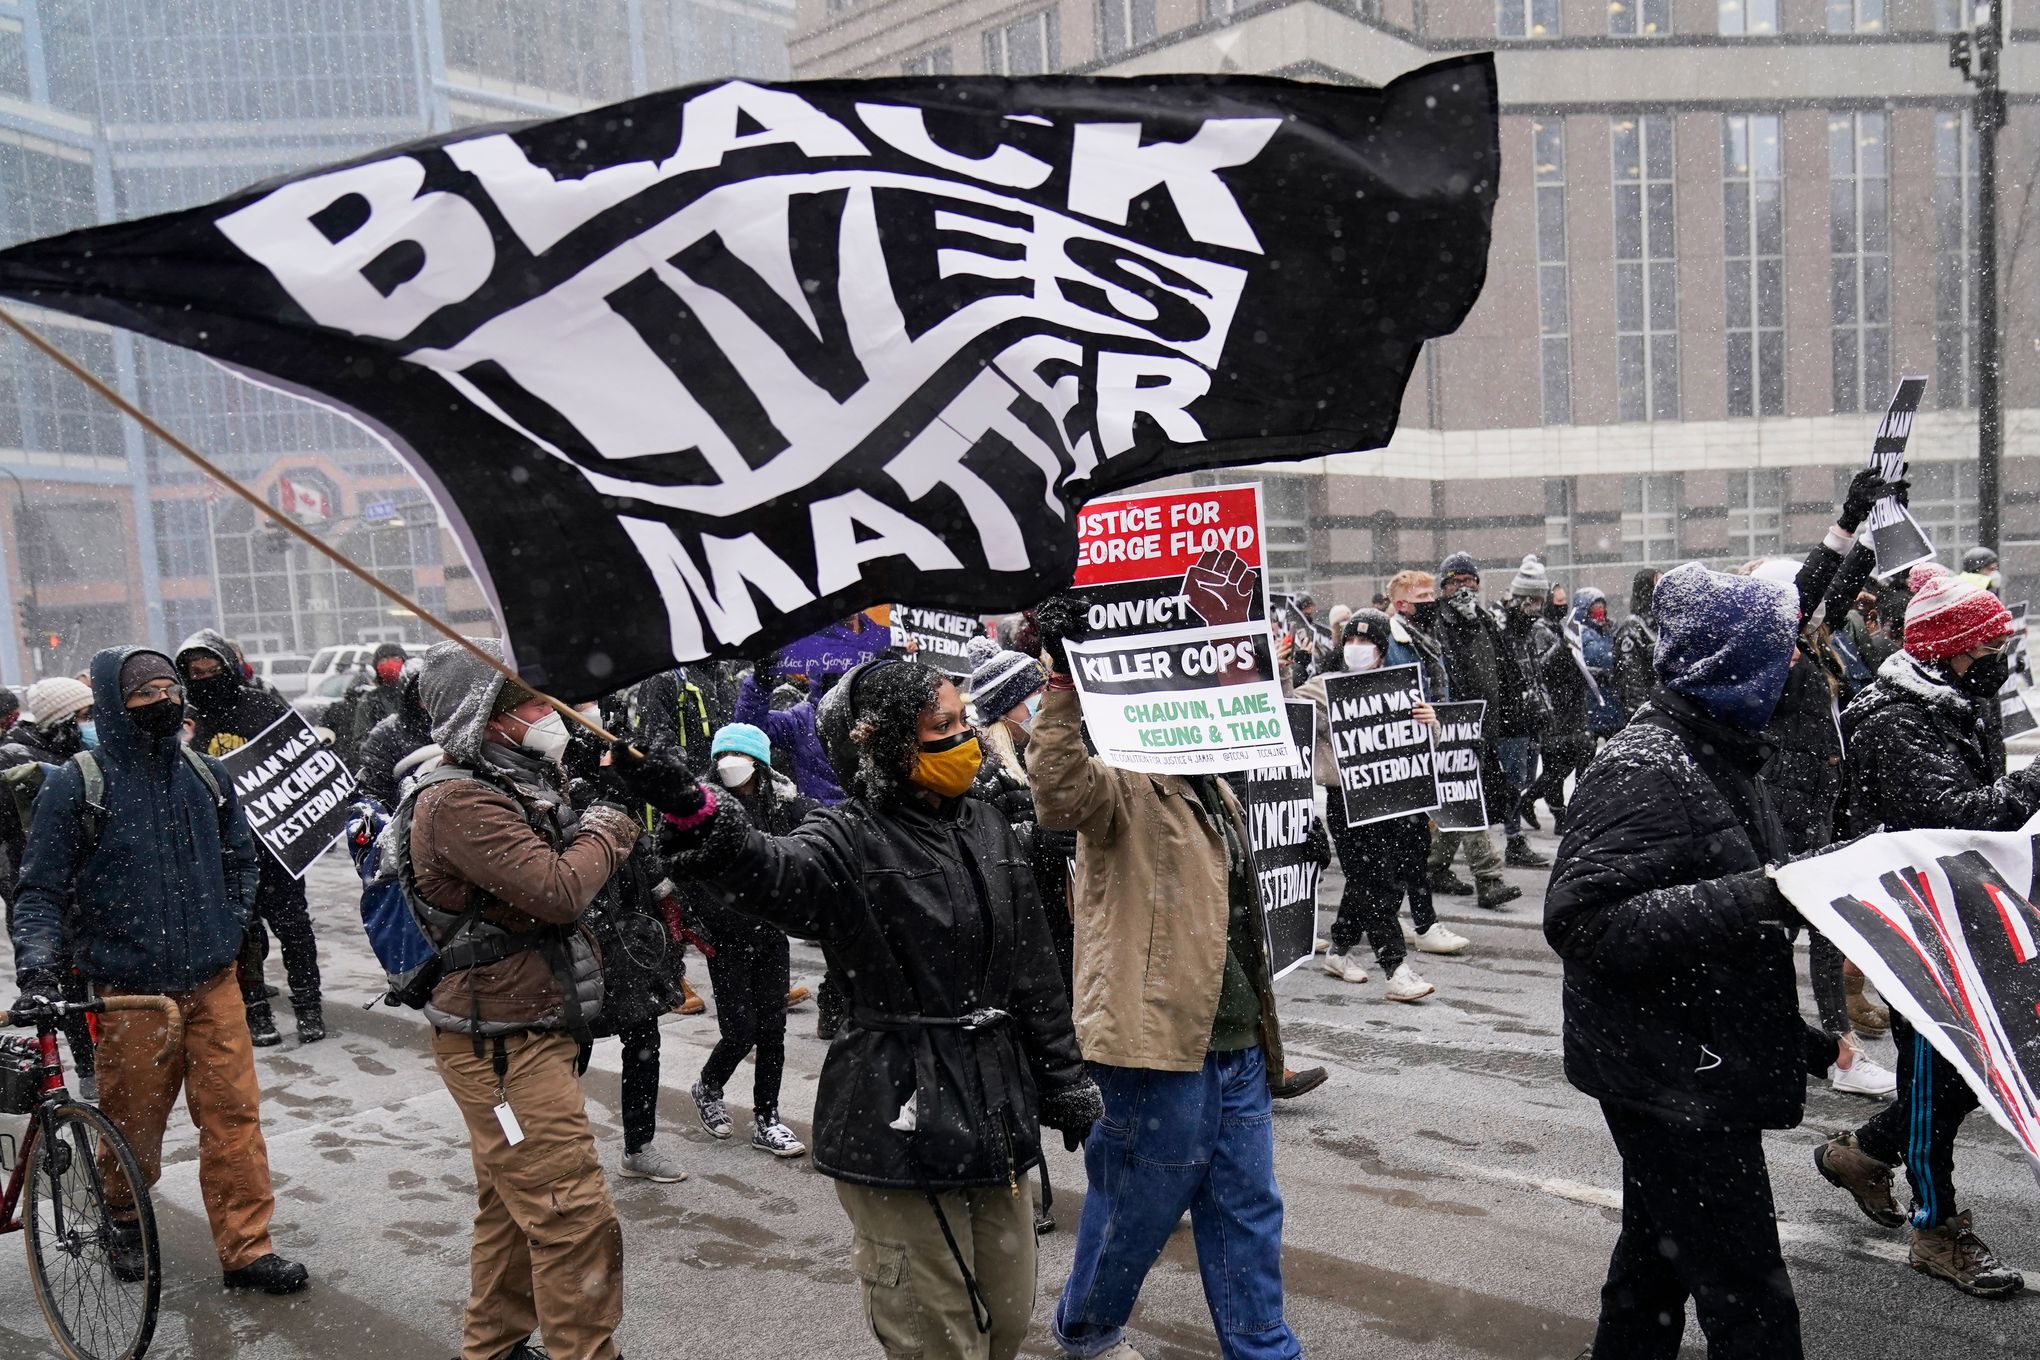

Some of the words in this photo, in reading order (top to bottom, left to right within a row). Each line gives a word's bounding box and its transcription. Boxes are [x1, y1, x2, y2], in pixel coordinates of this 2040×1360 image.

[214, 81, 1283, 342] BLACK
[457, 186, 1214, 486] LIVES
[617, 334, 1212, 662] MATTER
[1077, 506, 1161, 539] USTICE
[1170, 501, 1220, 528] FOR
[1077, 533, 1161, 566] EORGE
[1170, 525, 1254, 557] FLOYD
[910, 608, 978, 638] YNCHED
[1087, 594, 1192, 631] ONVICT
[1080, 651, 1174, 683] KILLER
[1181, 641, 1256, 678] COPS
[1123, 700, 1215, 723] CHAUVIN,
[1217, 693, 1277, 718] LANE,
[1331, 701, 1343, 723] A
[1343, 694, 1384, 721] MAN
[1383, 688, 1421, 713] WAS
[276, 728, 317, 763] WAS
[1138, 725, 1203, 747] KEUNG
[1208, 725, 1223, 743] &
[1227, 718, 1282, 742] THAO
[1334, 719, 1428, 759] LYNCHED
[1439, 724, 1456, 743] AN
[1457, 722, 1479, 741] WAS
[238, 755, 285, 792] MAN
[1341, 752, 1431, 791] YESTERDAY
[1436, 749, 1478, 774] NCHED
[233, 782, 247, 797] A
[244, 749, 337, 829] LYNCHED
[1439, 779, 1478, 803] TERDAY
[264, 772, 351, 851] YESTERDAY
[1258, 861, 1317, 913] ESTERDAY
